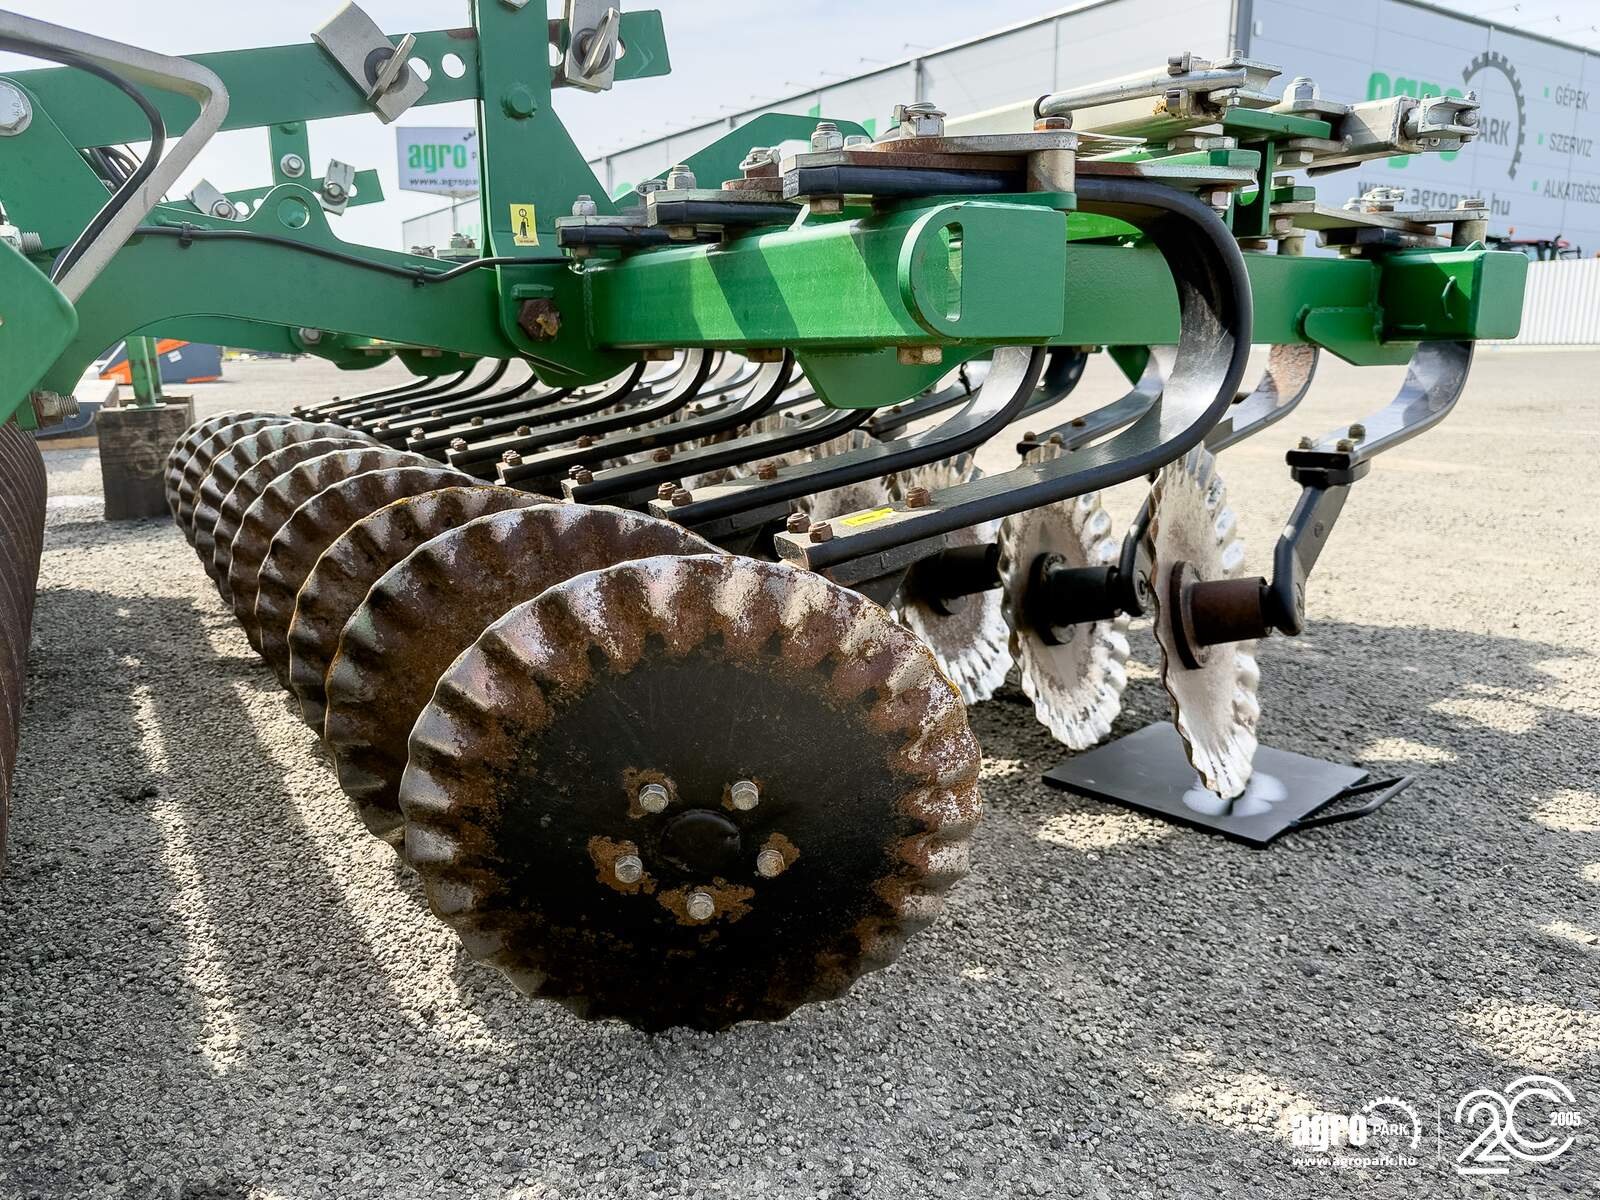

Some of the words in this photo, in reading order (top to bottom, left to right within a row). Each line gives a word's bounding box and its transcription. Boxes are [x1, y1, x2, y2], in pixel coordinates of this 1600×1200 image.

[1555, 83, 1589, 110] GÉPEK
[1476, 116, 1511, 146] ARK
[1549, 132, 1593, 157] SZERVIZ
[408, 144, 467, 173] agro
